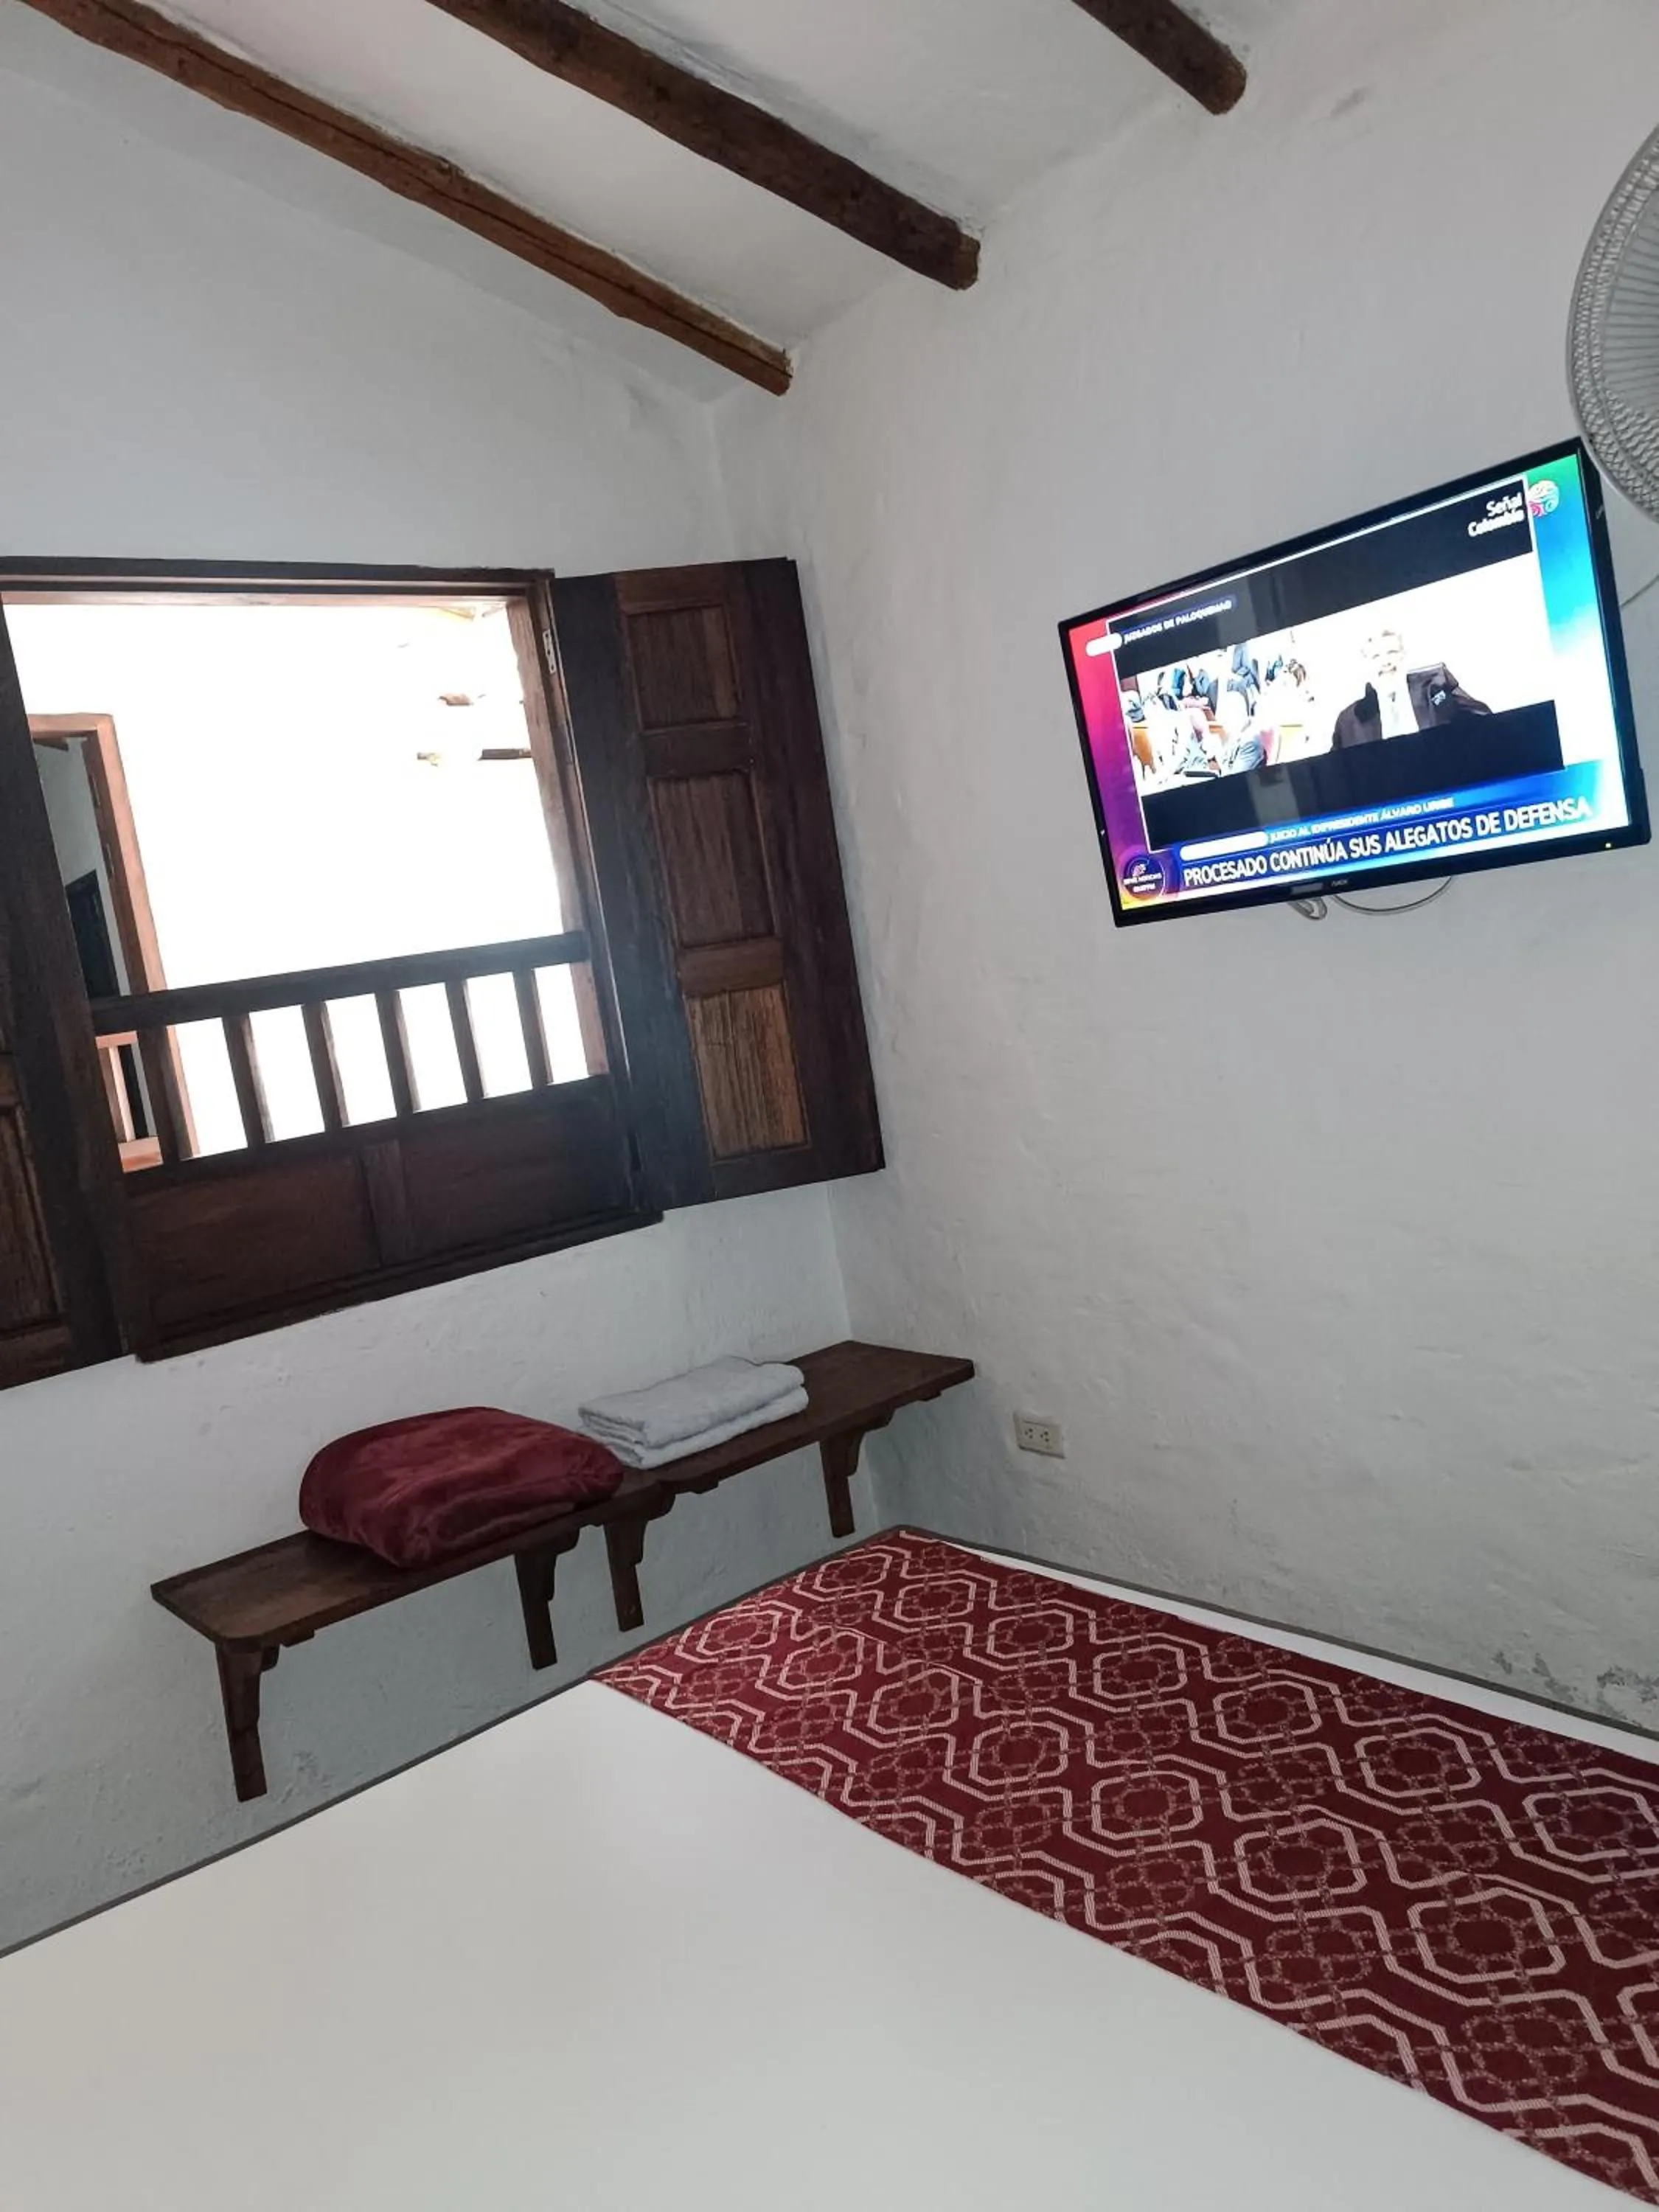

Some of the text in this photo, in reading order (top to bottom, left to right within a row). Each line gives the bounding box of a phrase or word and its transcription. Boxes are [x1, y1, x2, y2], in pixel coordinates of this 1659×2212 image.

[1486, 492, 1523, 517] Señal
[1164, 618, 1175, 630] DE
[1183, 796, 1593, 887] PROCESADO CONTINÚA SUS ALEGATOS DE DEFENSA
